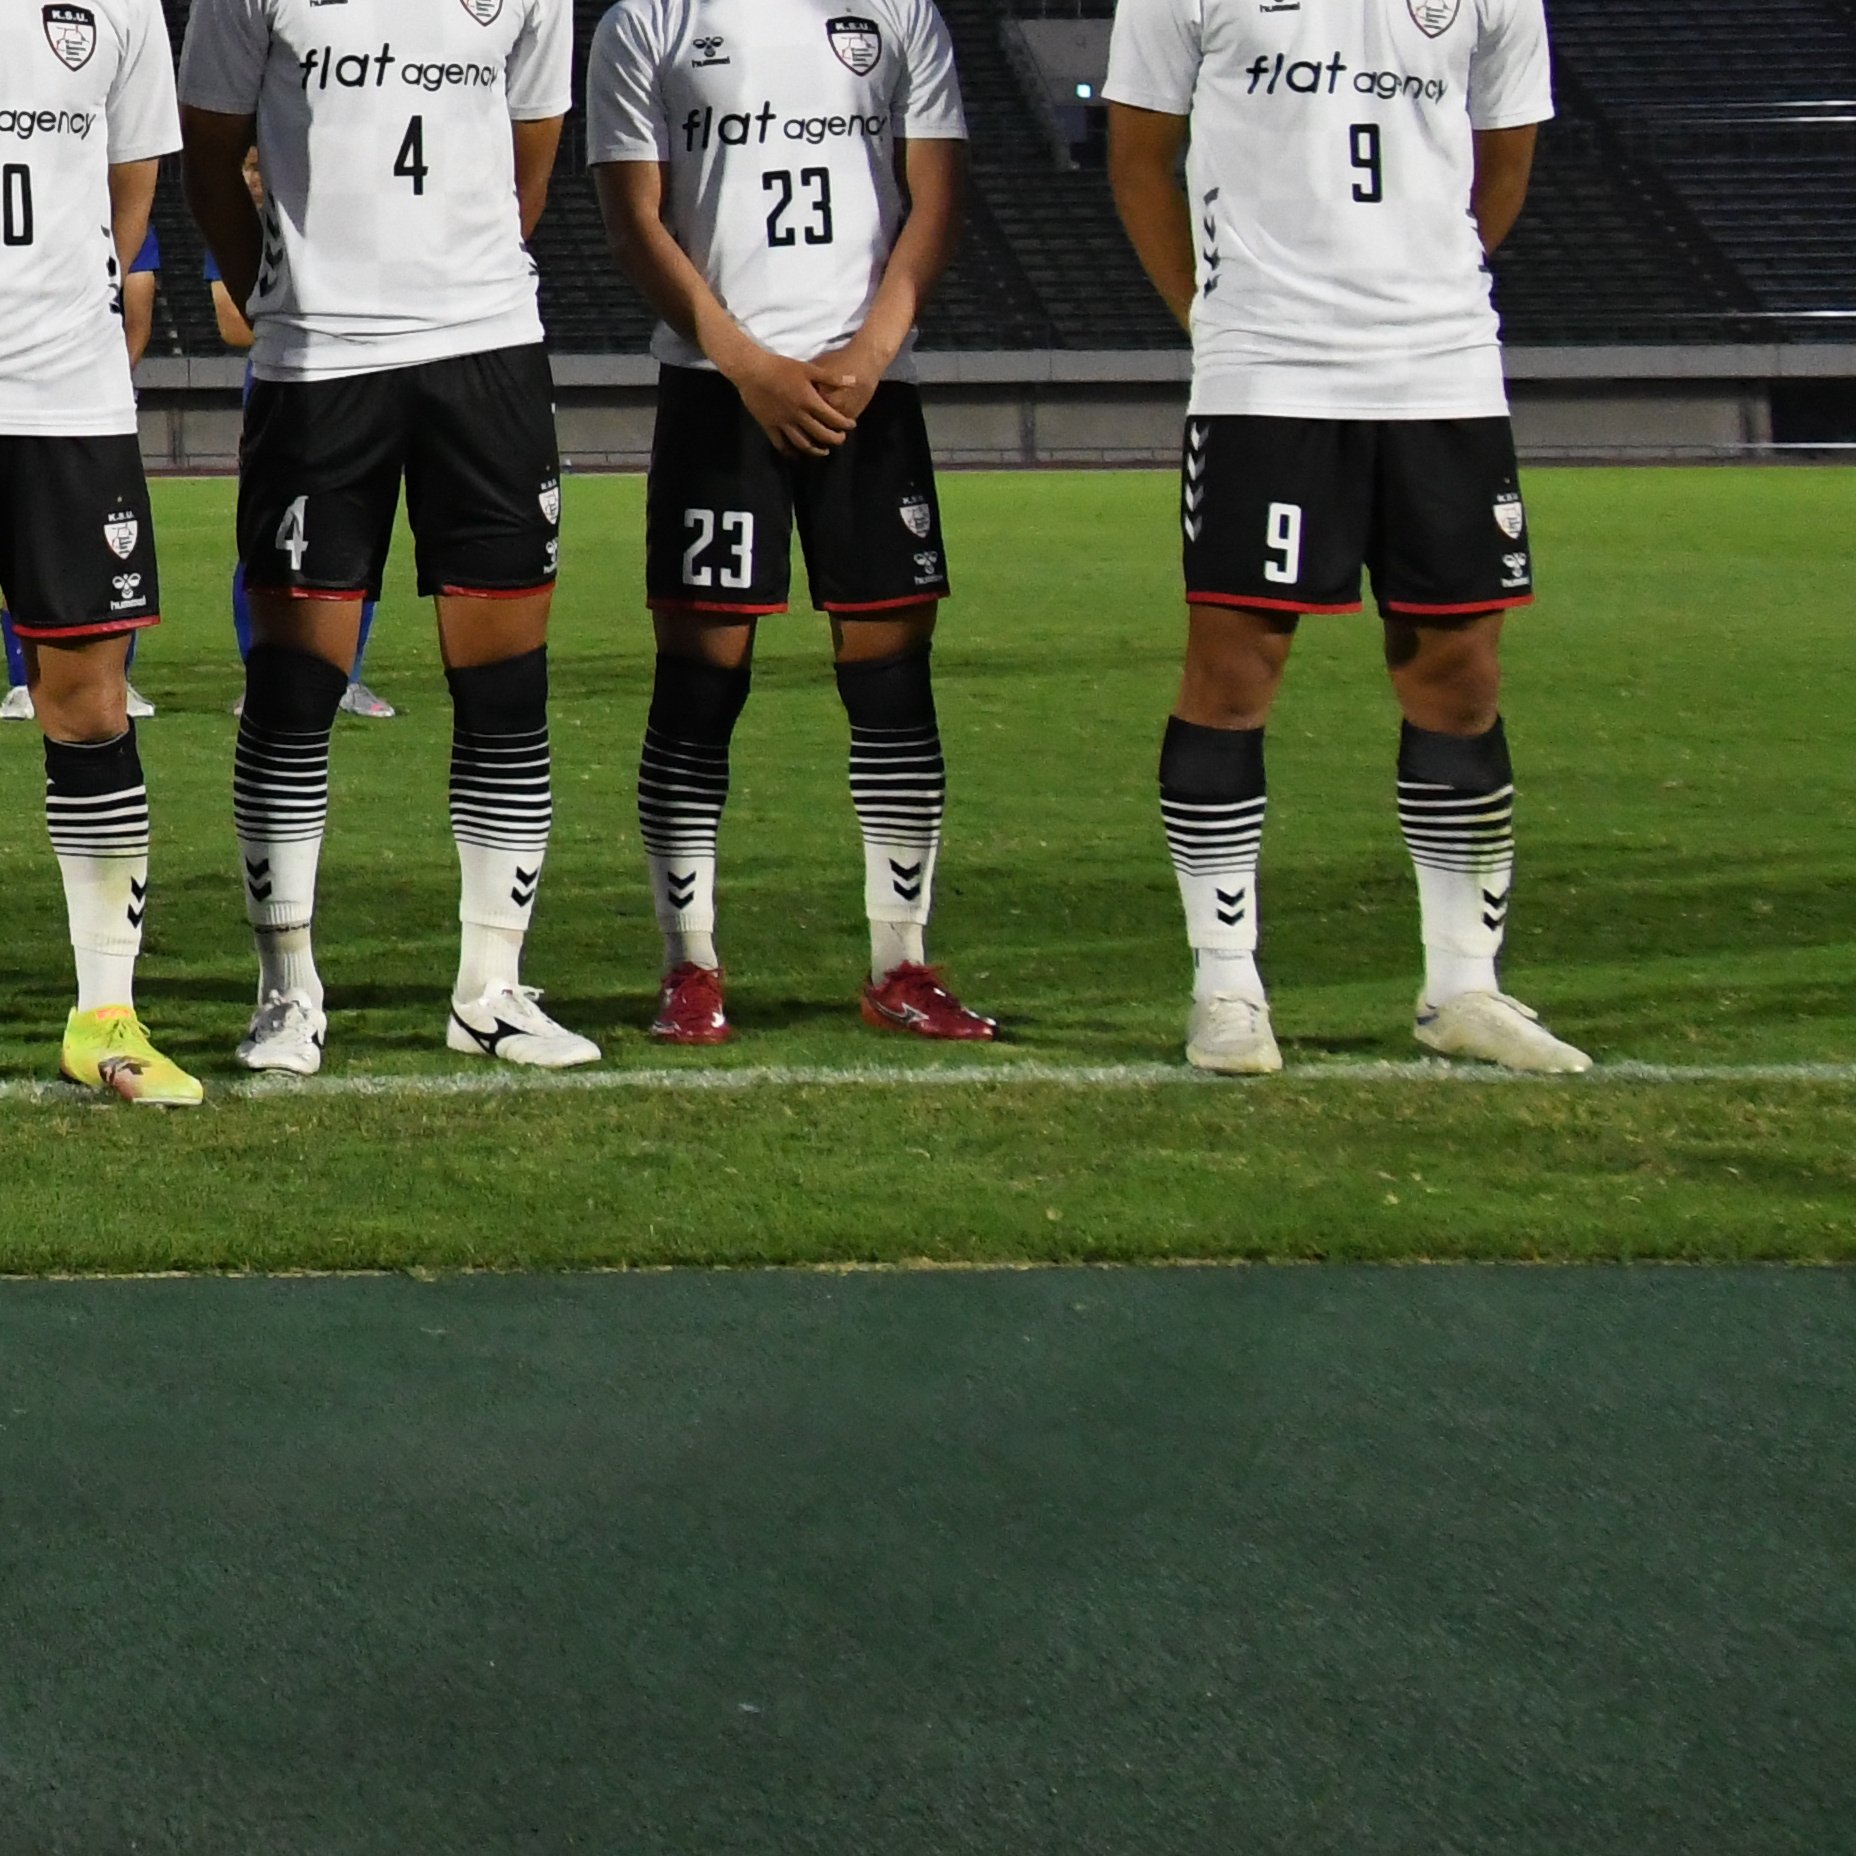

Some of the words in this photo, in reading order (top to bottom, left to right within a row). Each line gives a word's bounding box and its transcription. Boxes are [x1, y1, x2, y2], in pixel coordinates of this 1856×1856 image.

[51, 10, 89, 23] K.S.U.
[299, 43, 395, 90] flat
[1246, 51, 1347, 95] flat
[1353, 71, 1449, 105] agncy
[393, 115, 429, 195] 4
[682, 101, 776, 152] flat
[1349, 123, 1382, 203] 9
[762, 166, 833, 248] 23
[275, 495, 309, 570] 4
[683, 508, 754, 589] 23
[1264, 502, 1302, 584] 9
